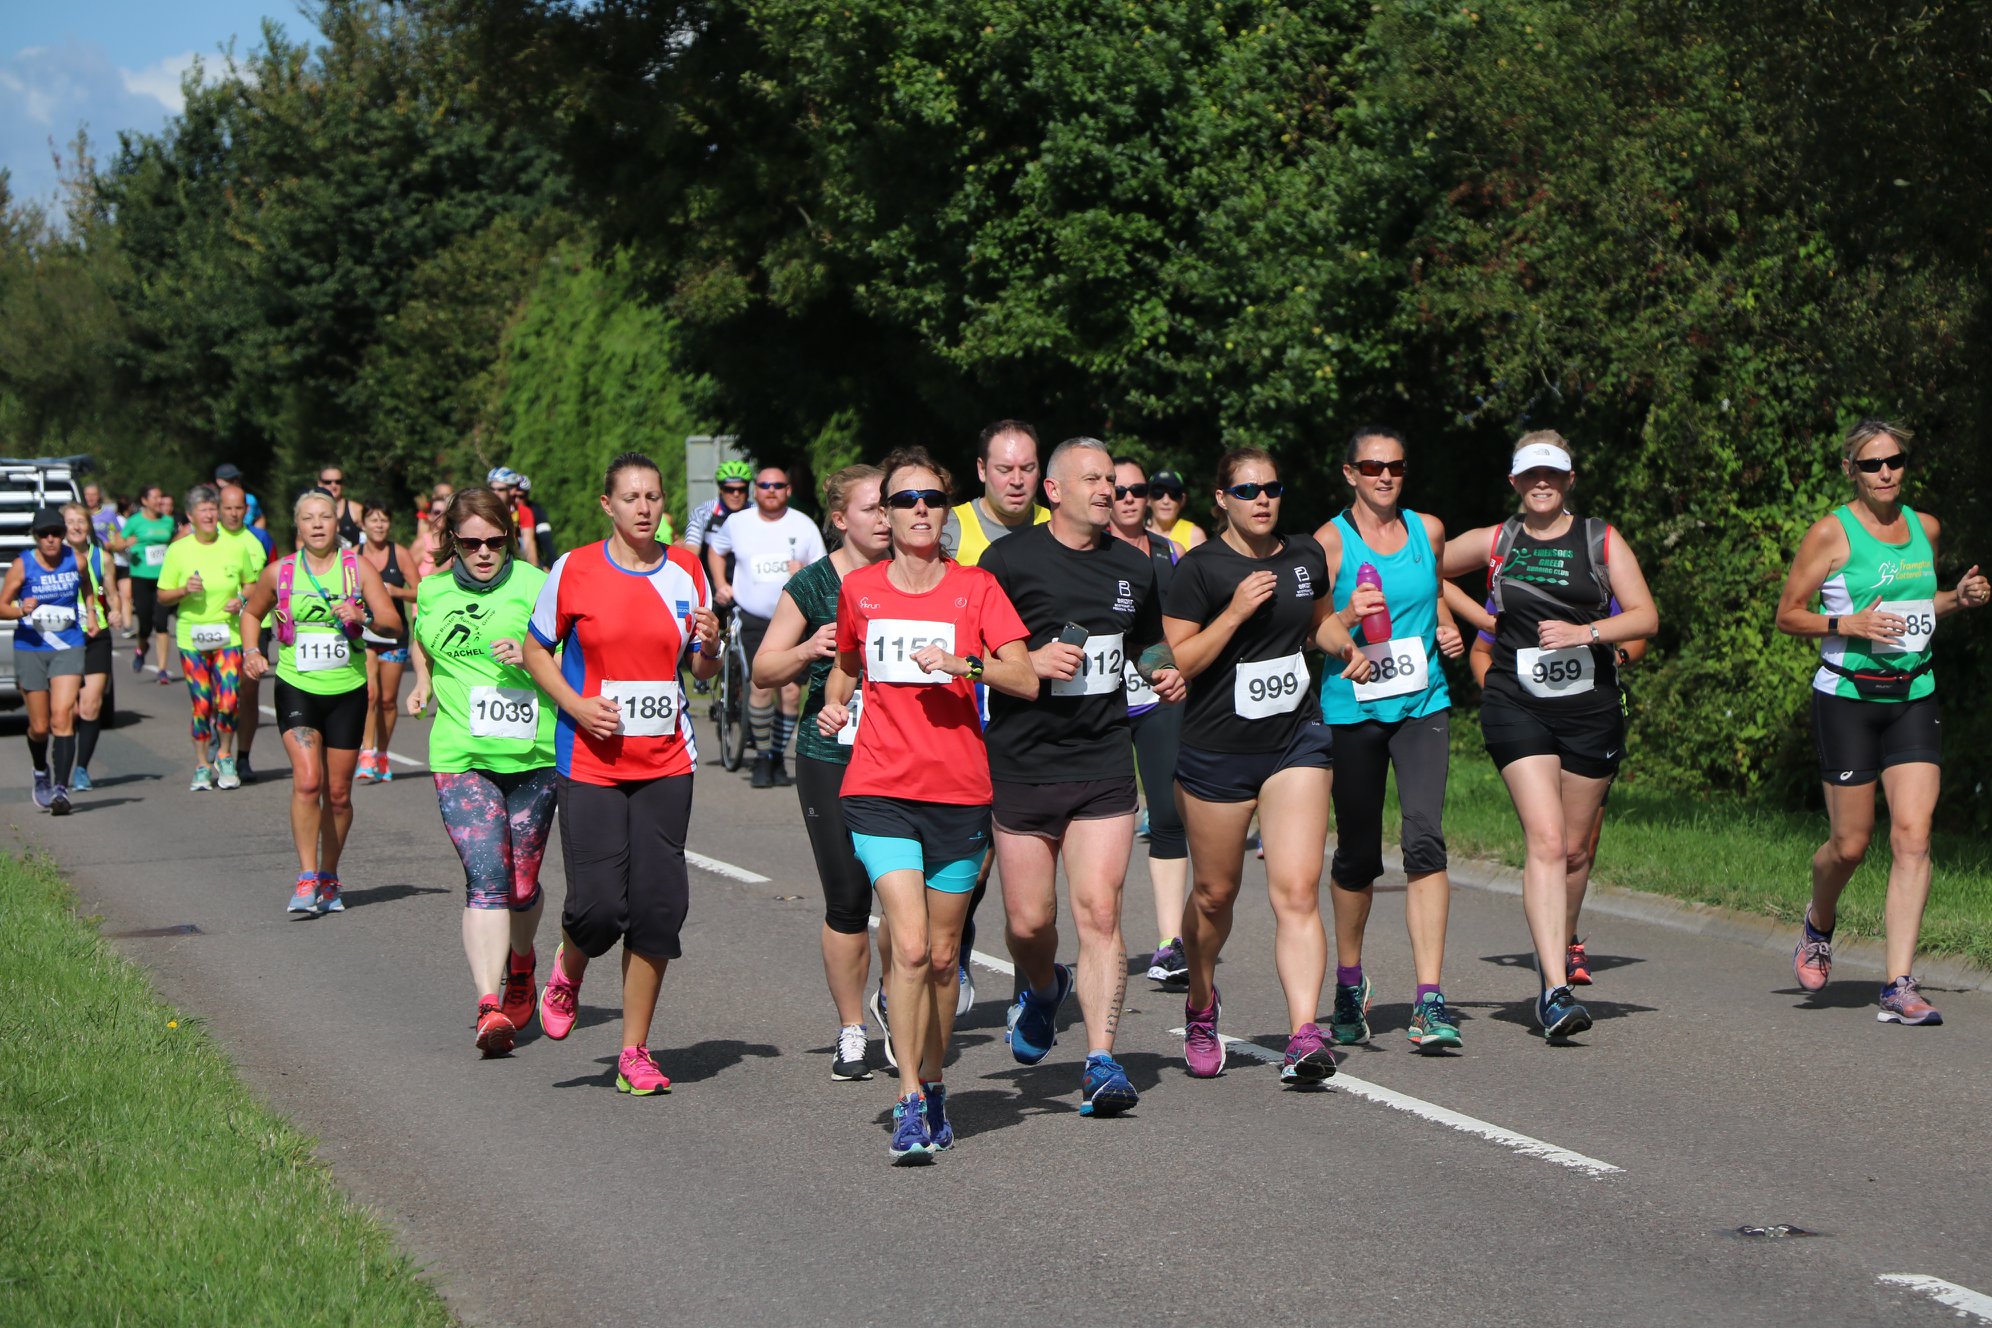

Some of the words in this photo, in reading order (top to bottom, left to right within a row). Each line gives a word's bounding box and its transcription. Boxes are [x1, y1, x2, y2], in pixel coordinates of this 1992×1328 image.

[755, 561, 790, 574] 1050
[300, 644, 346, 659] 1116
[447, 648, 485, 658] RACHEL
[1368, 654, 1415, 682] 988
[1532, 659, 1582, 683] 959
[1249, 672, 1298, 702] 999
[476, 700, 534, 723] 1039
